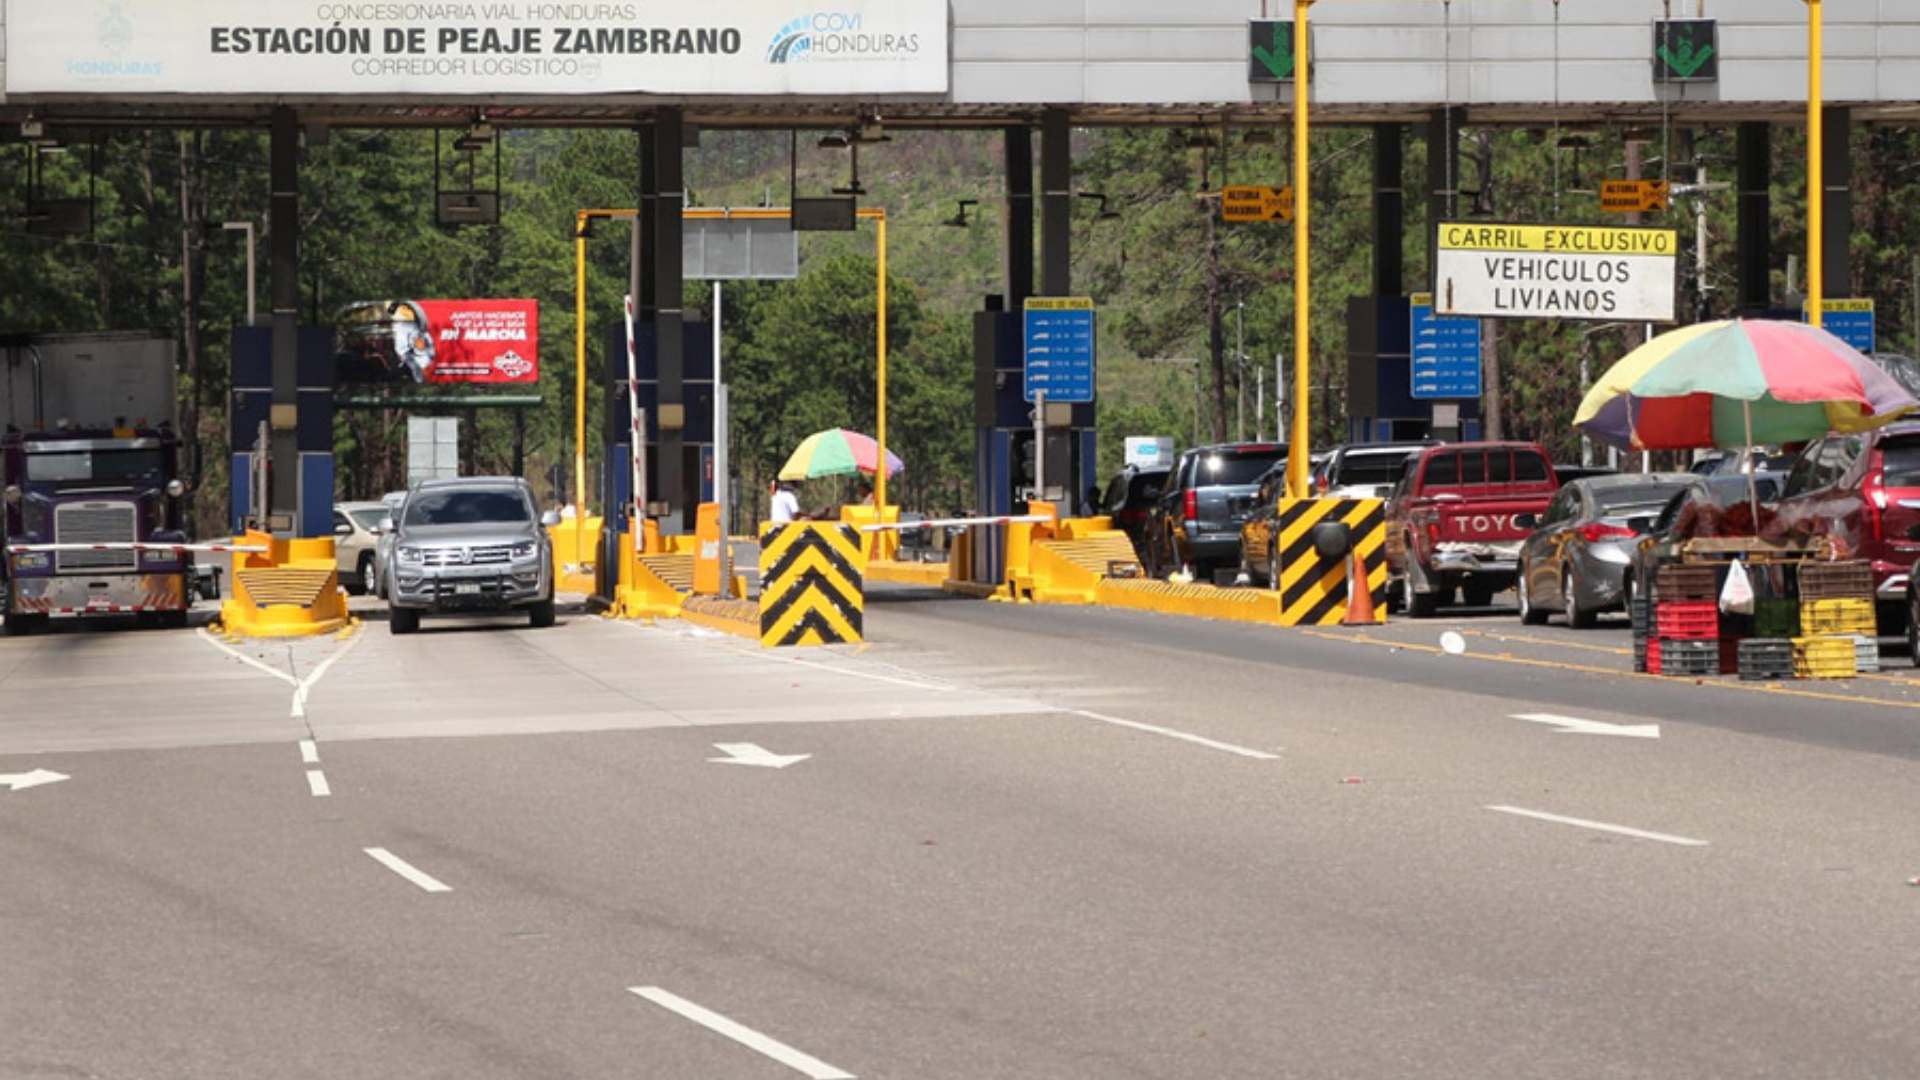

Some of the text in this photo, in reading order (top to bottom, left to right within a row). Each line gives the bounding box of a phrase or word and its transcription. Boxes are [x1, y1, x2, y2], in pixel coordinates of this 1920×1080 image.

[317, 3, 636, 21] CONCESIONARIA VIAL HONDURAS
[812, 12, 862, 32] COVI
[211, 21, 741, 54] ESTACIÓN DE PEAJE ZAMBRANO
[812, 33, 919, 54] HONDURAS
[67, 61, 162, 75] HONDURAS
[351, 58, 466, 76] CORREDOR
[1448, 228, 1668, 252] CARRIL EXCLUSIVO
[1484, 257, 1630, 283] VEHICULOS
[1494, 287, 1616, 313] LIVIANOS
[463, 329, 527, 341] MARCHA
